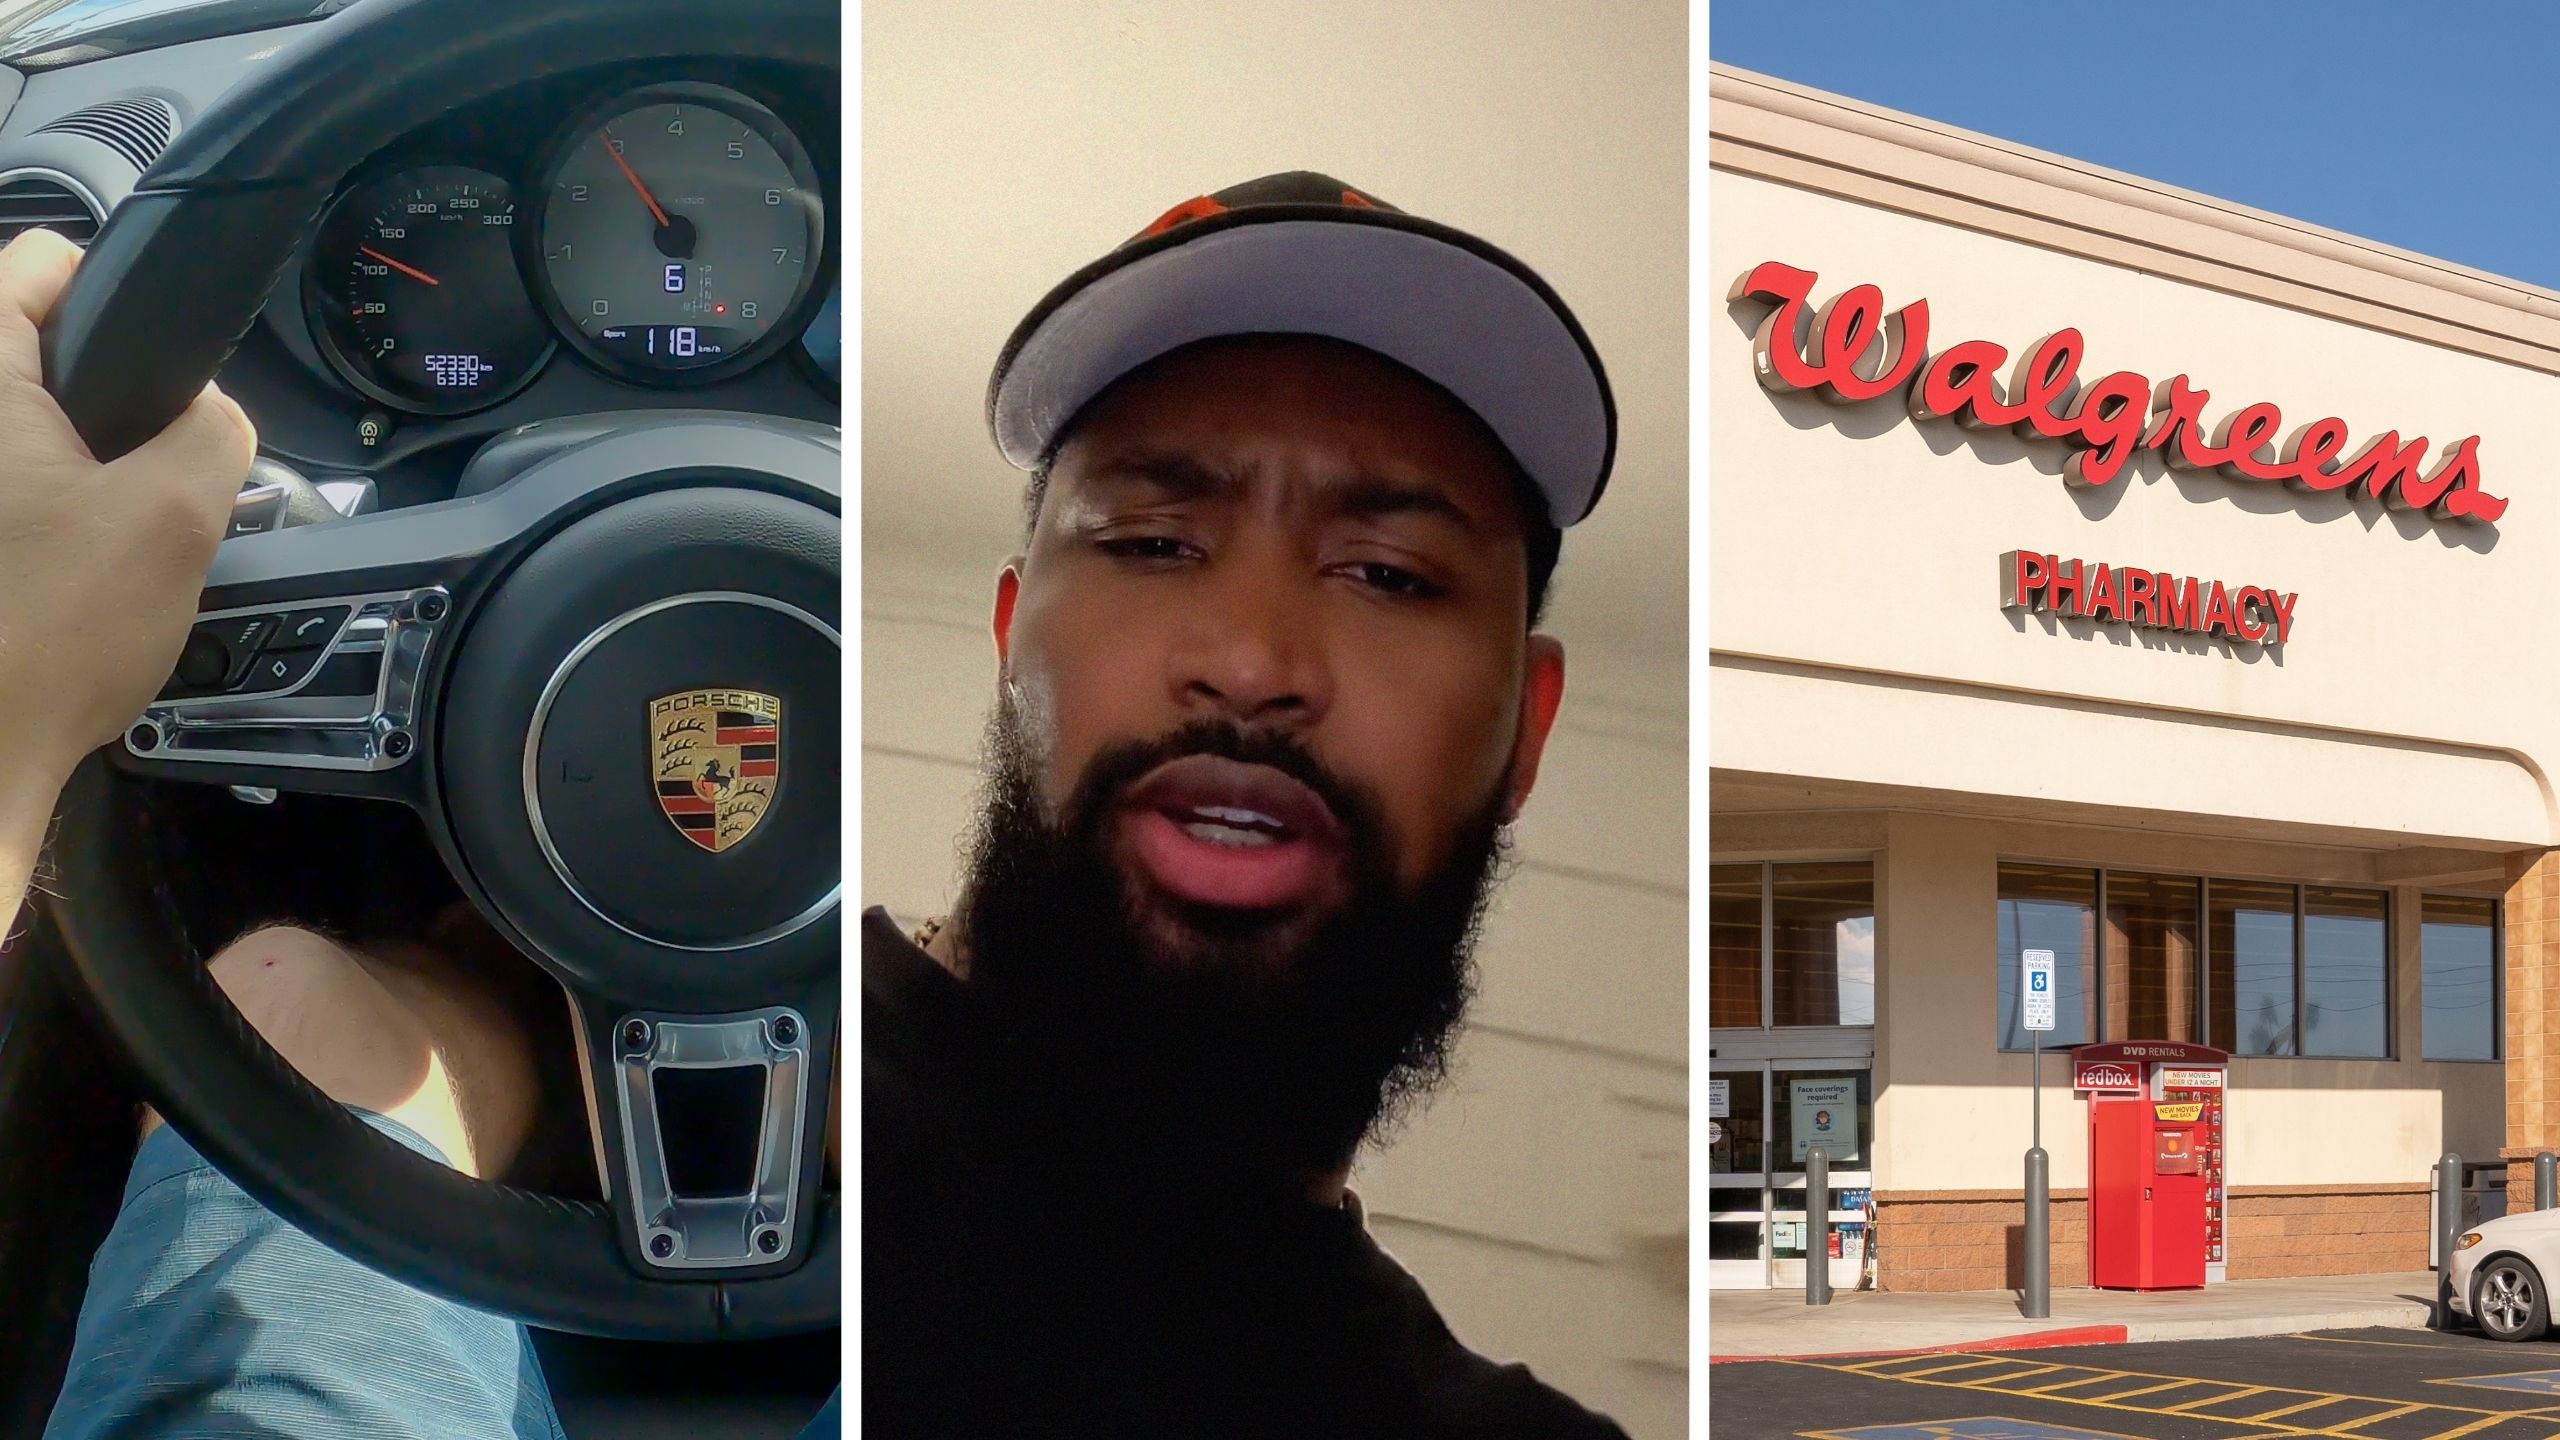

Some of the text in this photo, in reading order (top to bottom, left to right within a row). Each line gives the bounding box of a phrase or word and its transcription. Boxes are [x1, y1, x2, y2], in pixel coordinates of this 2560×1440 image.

[667, 119, 684, 137] 4
[610, 139, 624, 155] 3
[727, 142, 744, 159] 5
[571, 185, 588, 201] 2
[764, 189, 781, 205] 6
[407, 203, 437, 214] 200
[450, 199, 479, 208] 250
[483, 215, 513, 225] 300
[379, 228, 406, 239] 150
[561, 244, 573, 261] 1
[771, 248, 788, 264] 7
[362, 265, 388, 276] 100
[664, 264, 684, 292] 6
[364, 303, 386, 314] 50
[592, 300, 609, 316] 0
[741, 302, 757, 318] 8
[383, 338, 395, 349] 0
[648, 327, 696, 357] 118
[425, 355, 479, 371] 52330
[437, 372, 479, 386] 6332
[1736, 260, 2508, 523] Walgreens
[2010, 549, 2298, 645] PHARMACY
[656, 692, 777, 717] PORSCHE
[2027, 953, 2051, 961] RESERVED
[2028, 962, 2050, 970] PARKING
[2123, 1047, 2185, 1057] DVD RENTALS
[1815, 1085, 1848, 1093] coverings
[1807, 1093, 1838, 1102] required
[2160, 1105, 2199, 1114] NEW MOVIES
